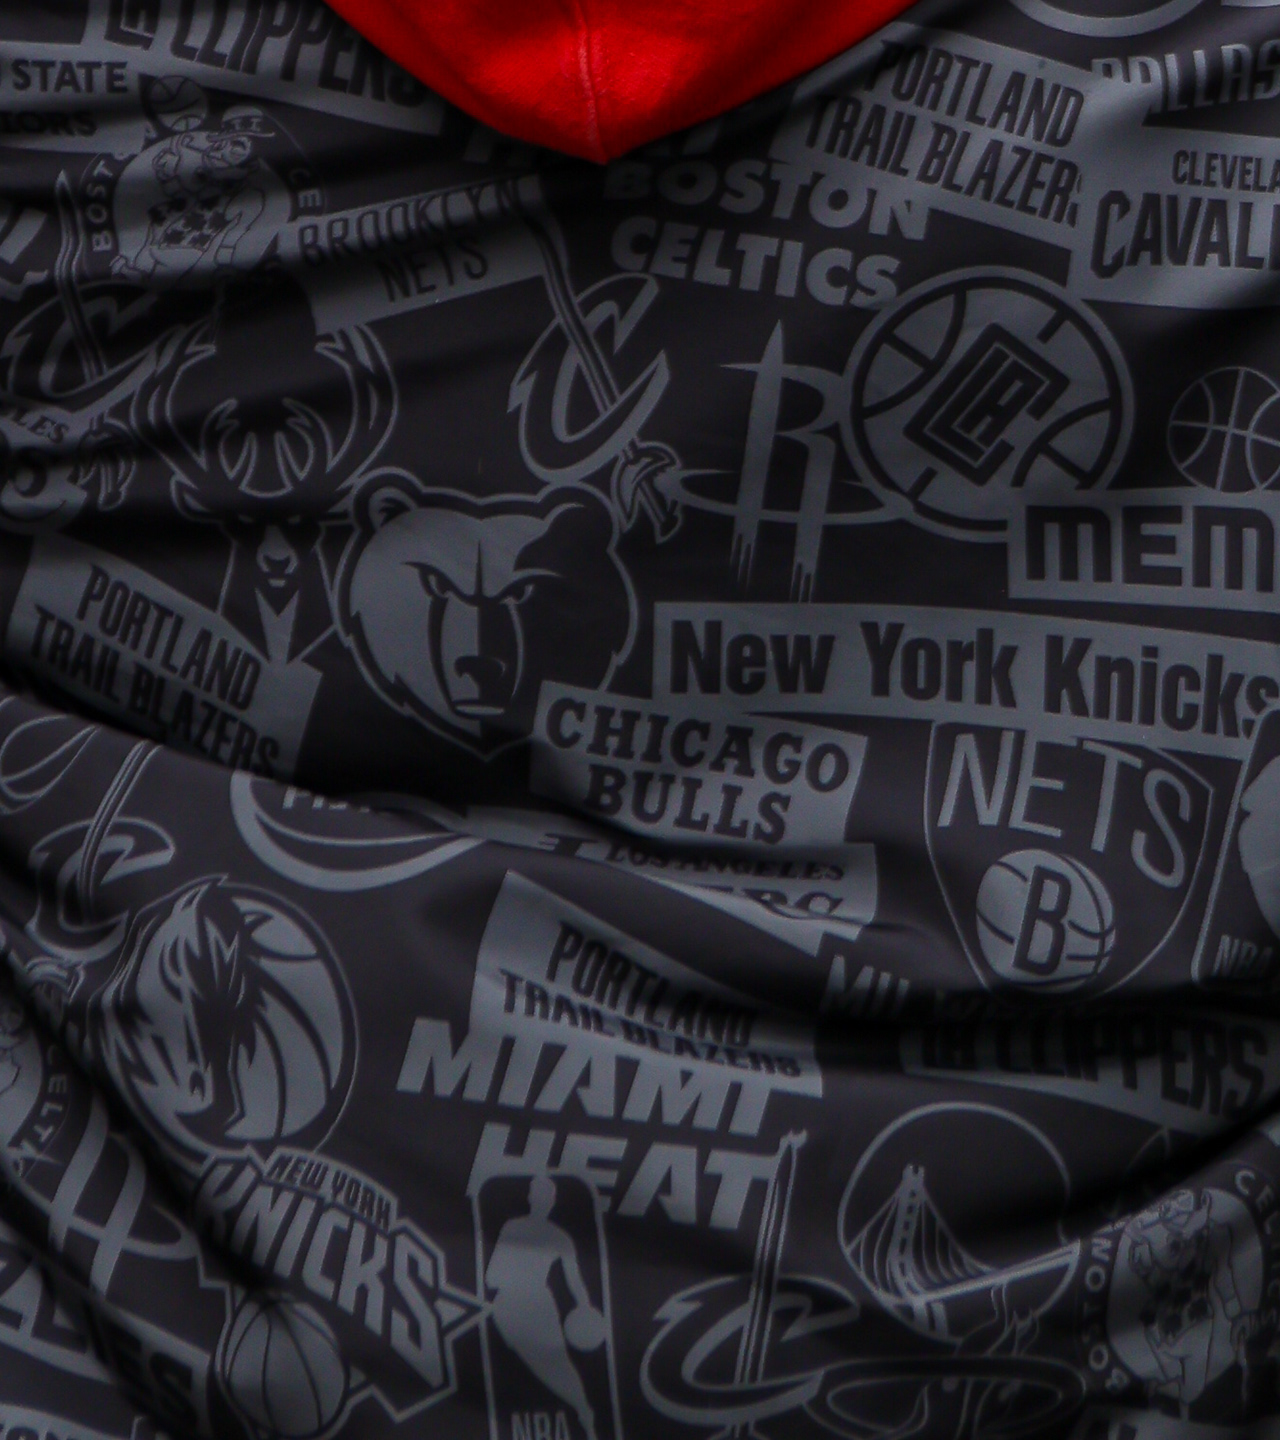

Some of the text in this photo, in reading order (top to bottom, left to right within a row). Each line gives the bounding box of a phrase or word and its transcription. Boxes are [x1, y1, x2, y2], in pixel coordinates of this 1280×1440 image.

[11, 58, 129, 95] STATE
[875, 37, 1084, 149] PORTLAND
[804, 92, 915, 180] TRAIL
[297, 178, 520, 268] BROOKLYN
[603, 157, 929, 242] BOSTON
[375, 233, 488, 303] NETS
[609, 214, 902, 310] CELTICS
[30, 602, 280, 780] TRAIL BLAZERS
[75, 562, 262, 712] PORTLAND
[668, 618, 1280, 742] New York Knicks
[545, 689, 851, 794] CHICAGO
[581, 763, 793, 846] BULLS
[936, 728, 1193, 889] NETS
[547, 920, 760, 1048] PORTLAND
[396, 1016, 773, 1139] MIAMI
[464, 1122, 782, 1232] HEAT
[195, 1160, 447, 1392] KNICKS
